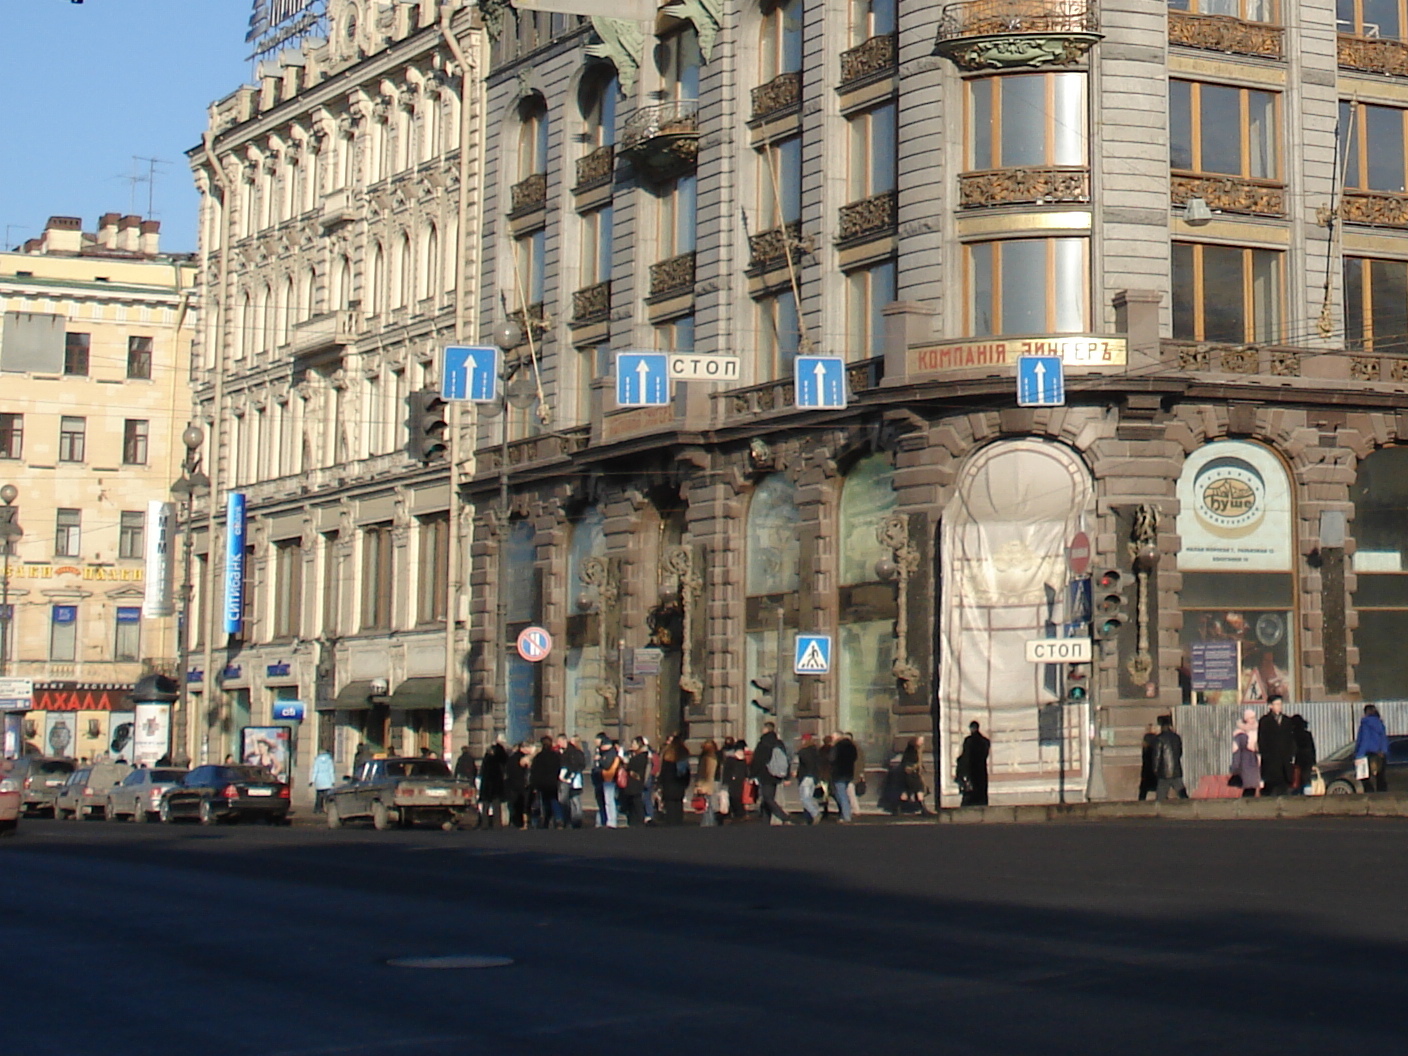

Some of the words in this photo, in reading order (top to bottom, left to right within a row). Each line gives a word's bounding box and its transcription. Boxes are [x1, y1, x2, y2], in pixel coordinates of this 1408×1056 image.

[918, 343, 1006, 370] КОМПАНІЯ
[673, 359, 736, 376] СТОП
[1034, 643, 1081, 658] СТОП
